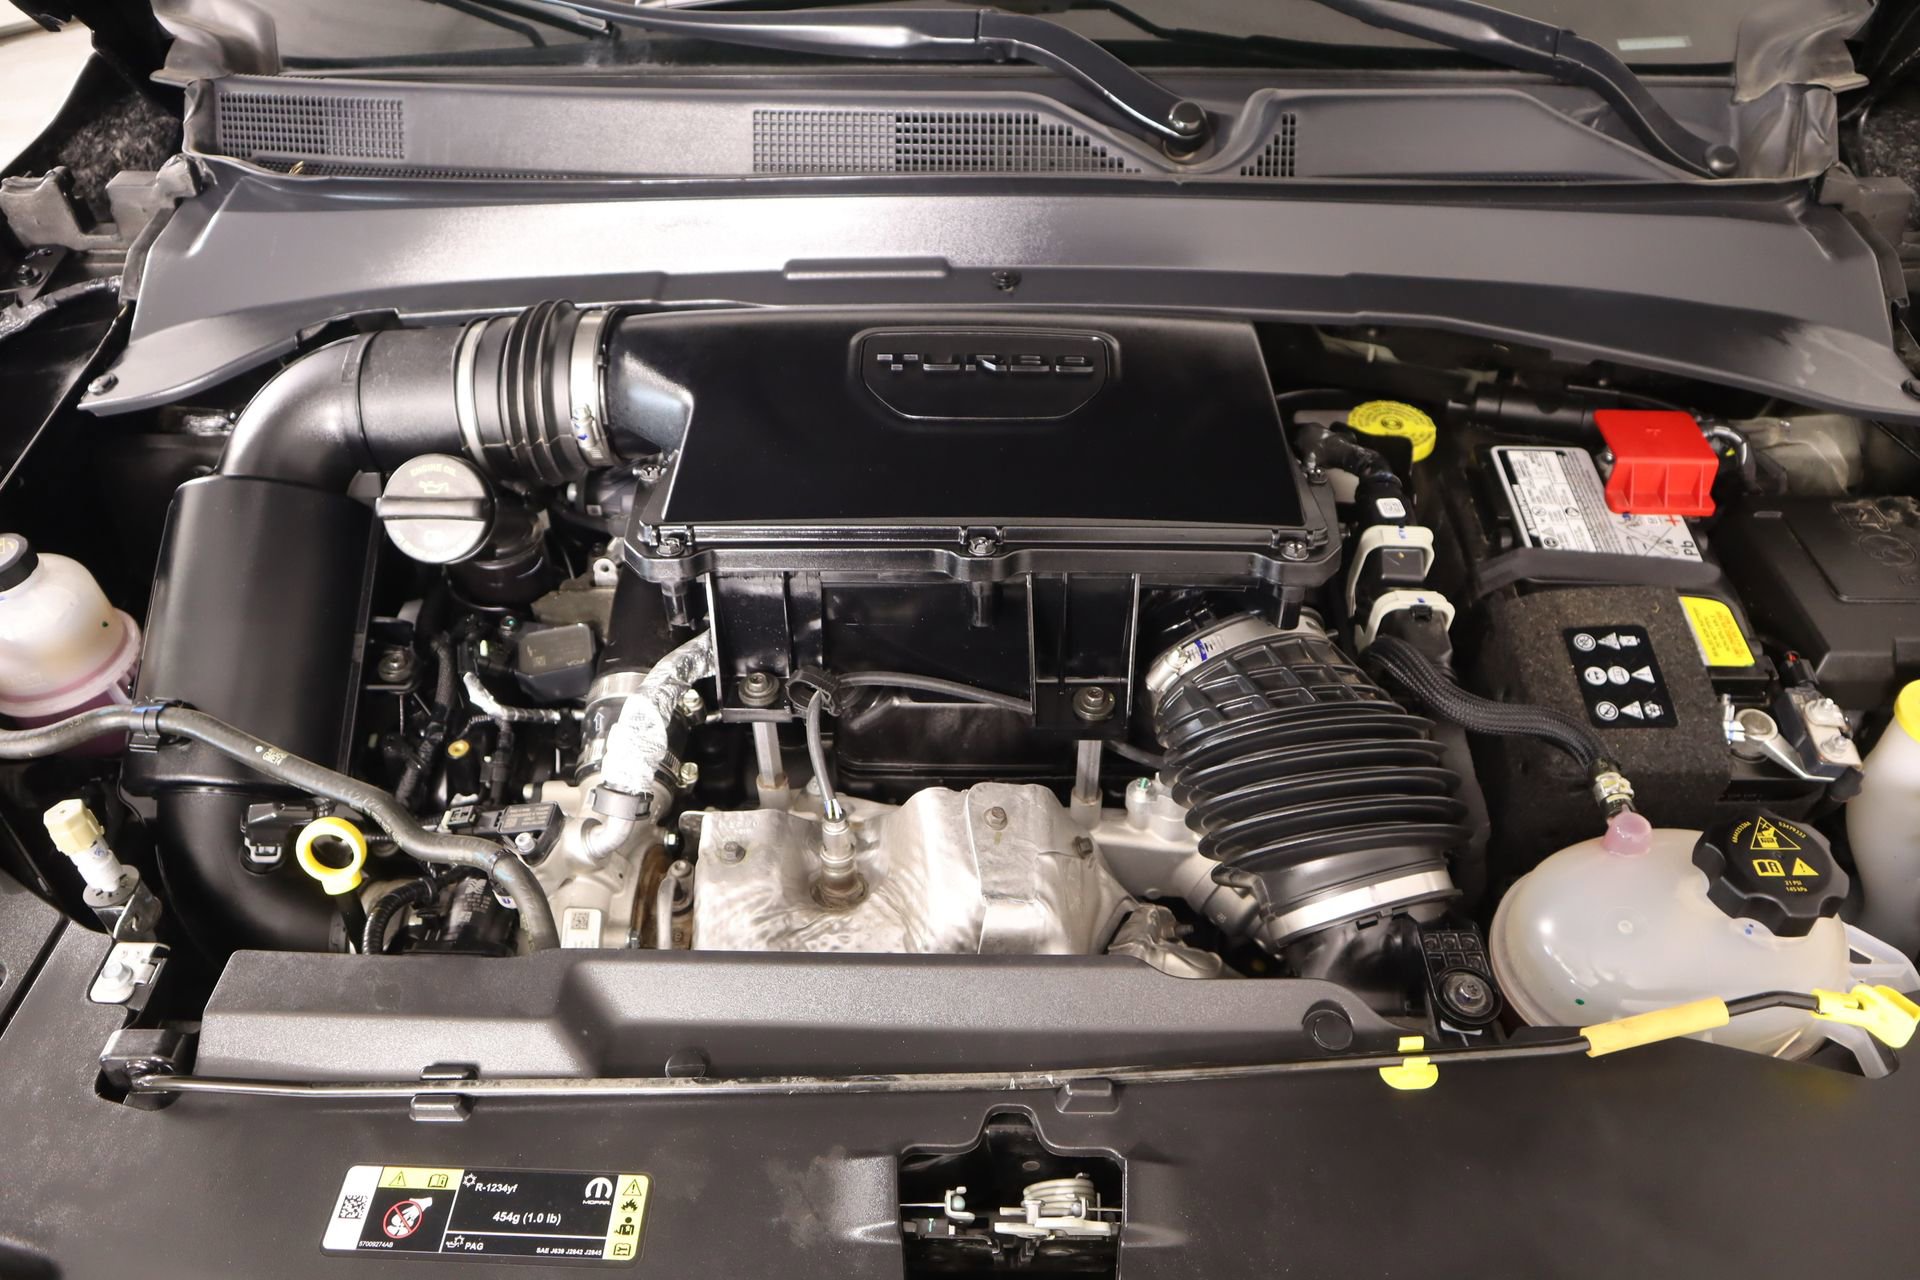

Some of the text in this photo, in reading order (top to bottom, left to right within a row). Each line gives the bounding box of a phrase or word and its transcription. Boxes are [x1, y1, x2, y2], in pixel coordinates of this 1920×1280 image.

[876, 353, 1095, 373] TURBO
[1681, 540, 1699, 557] Pb
[474, 1182, 518, 1195] R-1234yf
[492, 1211, 561, 1226] 454g (1.0 lb)
[464, 1241, 484, 1252] PAG
